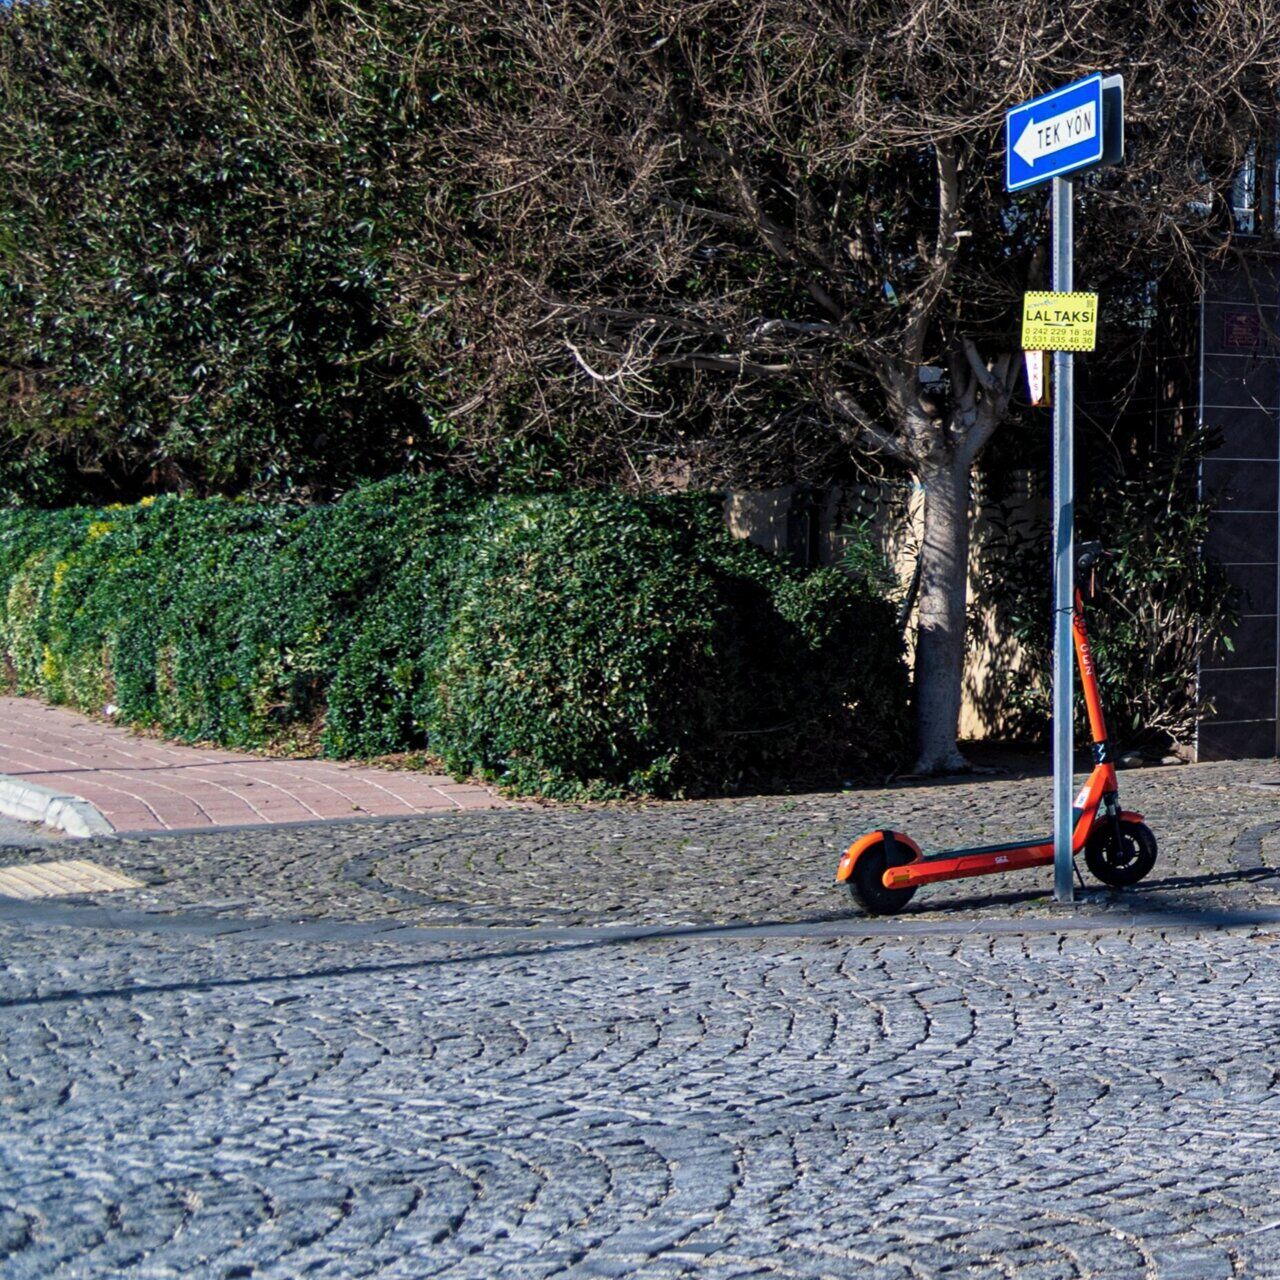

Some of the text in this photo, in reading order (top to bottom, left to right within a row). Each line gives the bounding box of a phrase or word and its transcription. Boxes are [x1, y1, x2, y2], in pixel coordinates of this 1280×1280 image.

[1037, 109, 1092, 149] TEK YÖN
[1026, 308, 1094, 323] LAL TAKSİ
[1025, 327, 1031, 335] 0
[1033, 327, 1048, 335] 242
[1050, 328, 1067, 336] 229
[1082, 329, 1093, 337] 30
[1032, 335, 1047, 343] 531
